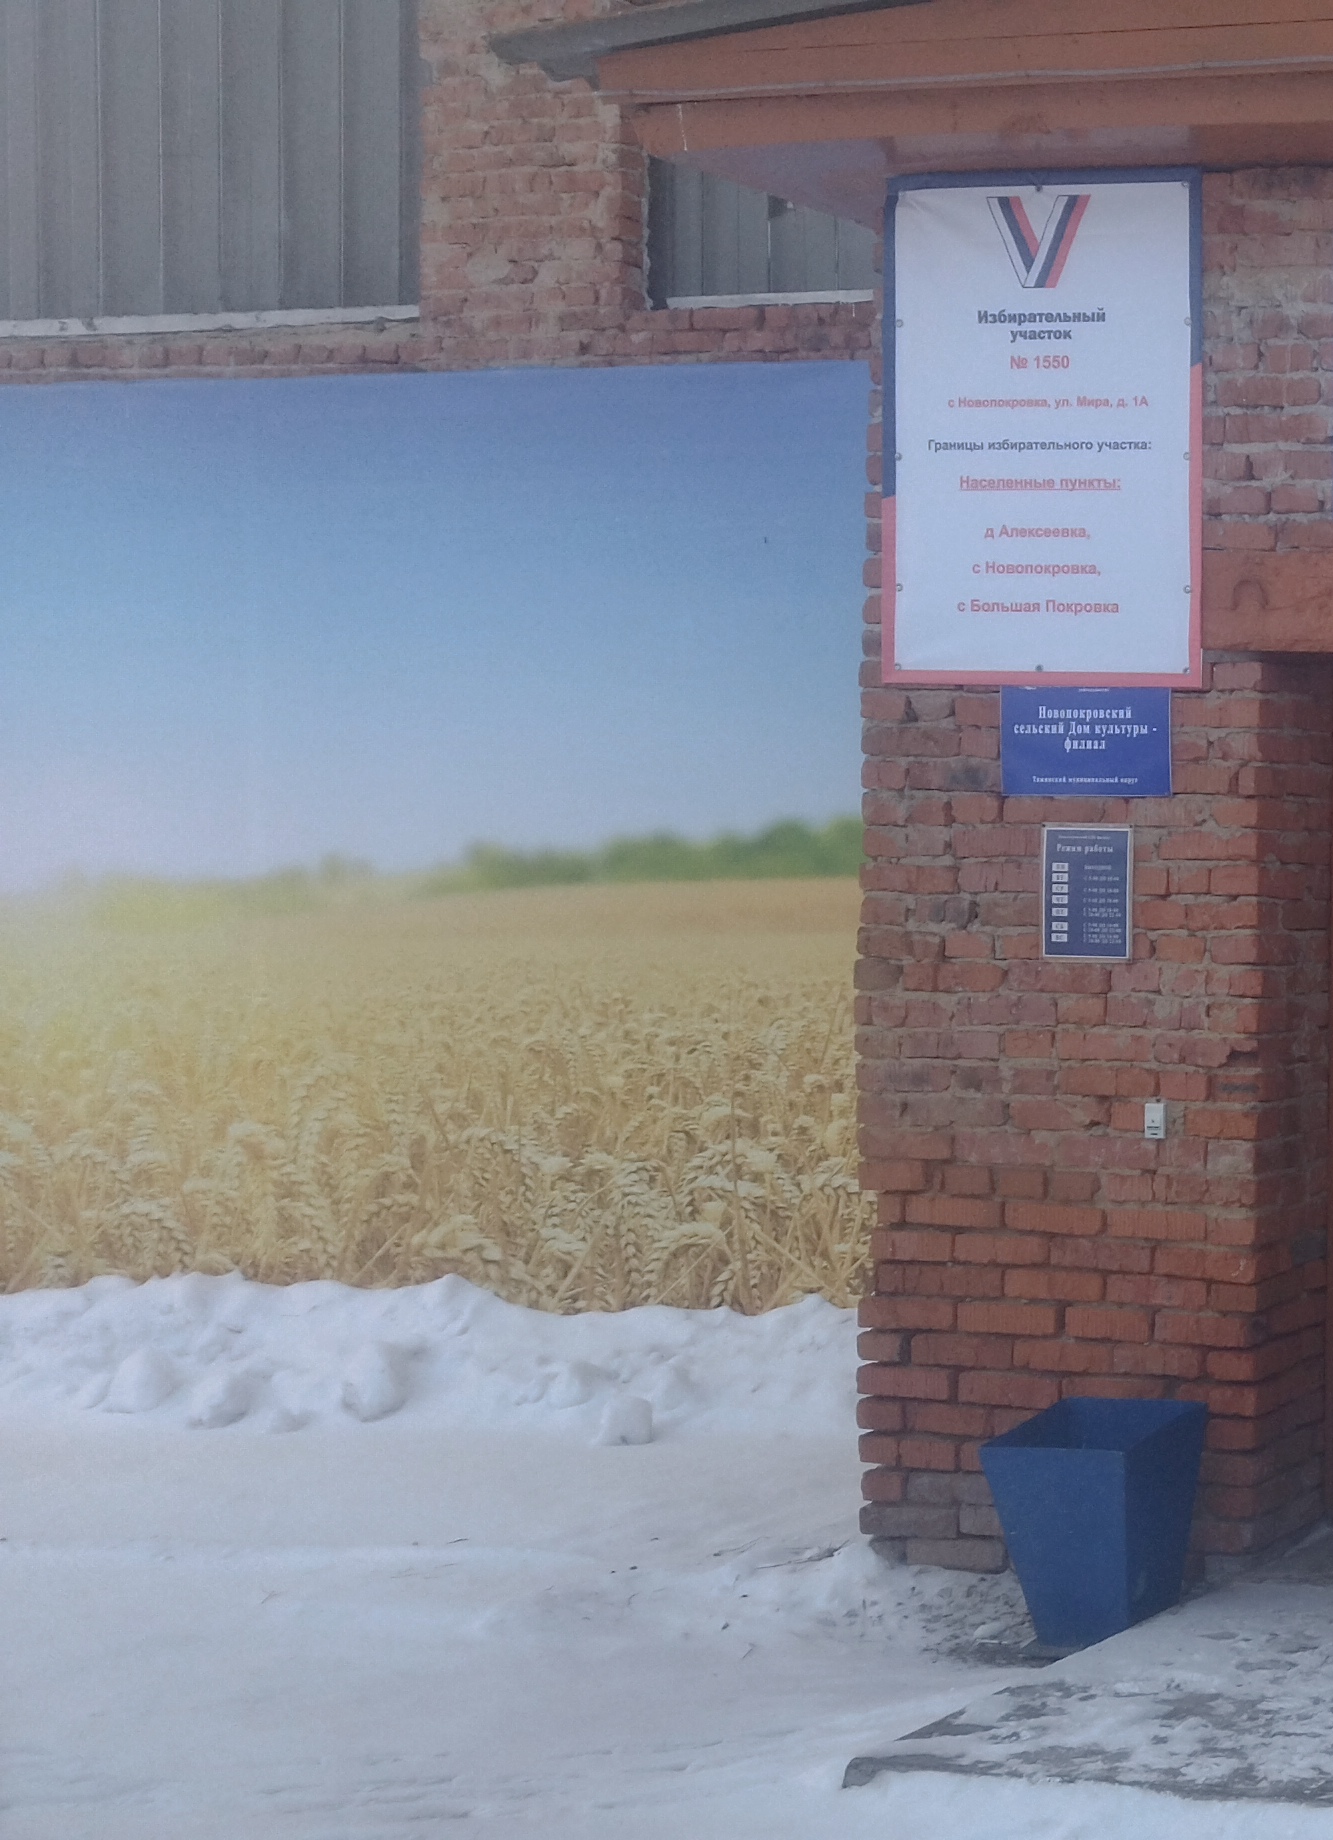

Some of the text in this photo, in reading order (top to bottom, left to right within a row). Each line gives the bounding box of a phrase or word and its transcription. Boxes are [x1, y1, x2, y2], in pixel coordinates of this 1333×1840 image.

[977, 307, 1106, 326] Избирательный
[1010, 329, 1073, 344] участок
[1009, 354, 1070, 371] № 1550
[1054, 398, 1073, 410] ул.
[1076, 395, 1113, 410] Мира,
[927, 438, 1152, 453] Границы избирательного участка:
[959, 476, 1121, 492] Населенные пункты:
[983, 524, 1091, 540] д Алексеевка,
[972, 561, 1101, 577] с Новопокровка,
[957, 599, 1119, 616] с Большая Покровка
[1038, 705, 1132, 722] Новопокровский
[1013, 721, 1065, 734] сельский
[1068, 718, 1090, 736] Дом
[1094, 724, 1148, 738] культуры
[1064, 736, 1106, 753] филиал
